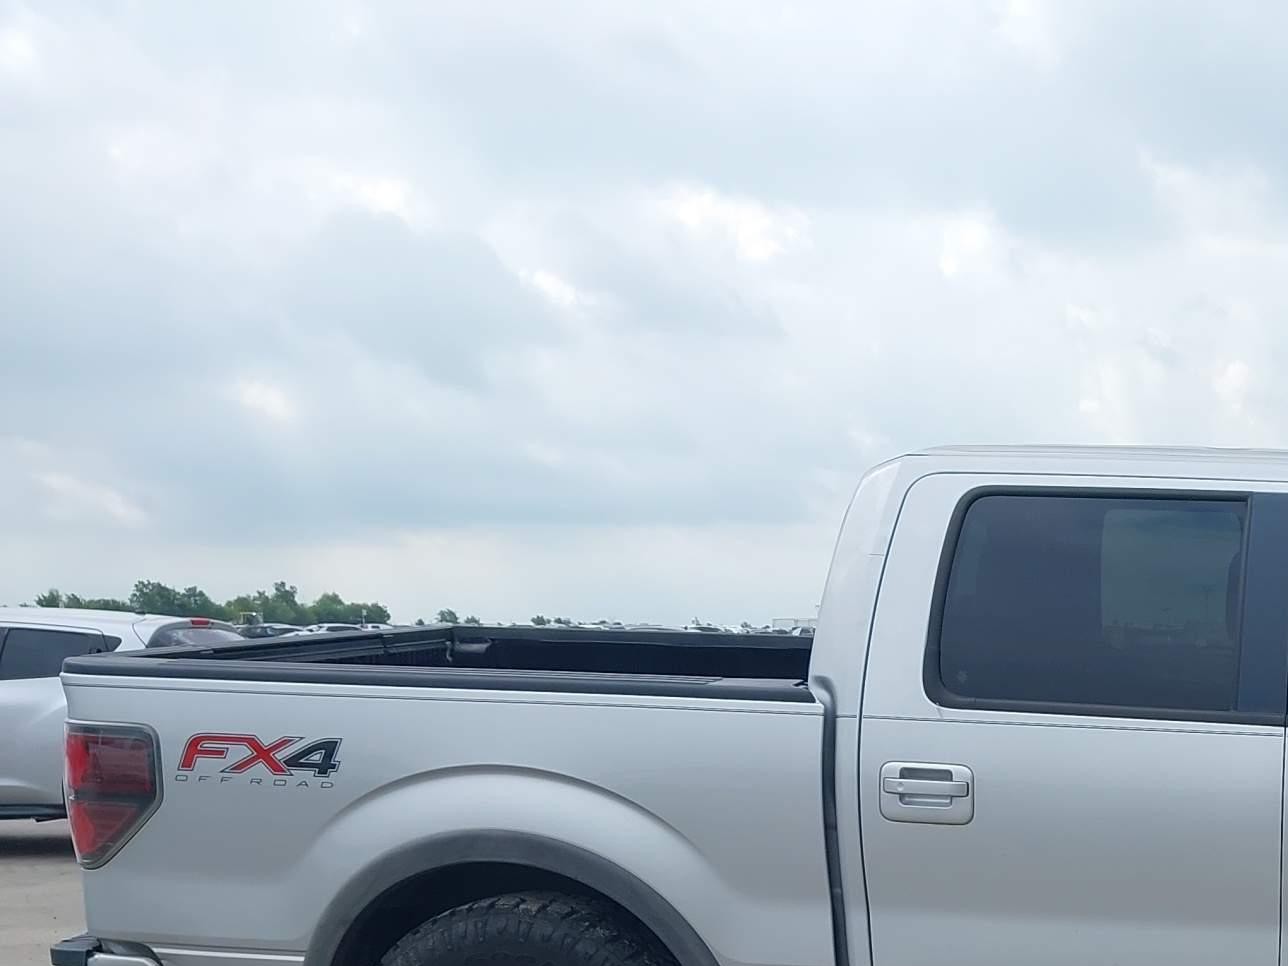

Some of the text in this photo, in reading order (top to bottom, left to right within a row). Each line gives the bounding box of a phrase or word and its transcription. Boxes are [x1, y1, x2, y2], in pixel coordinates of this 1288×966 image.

[177, 732, 343, 778] FX4
[174, 774, 335, 789] OFF ROAD
